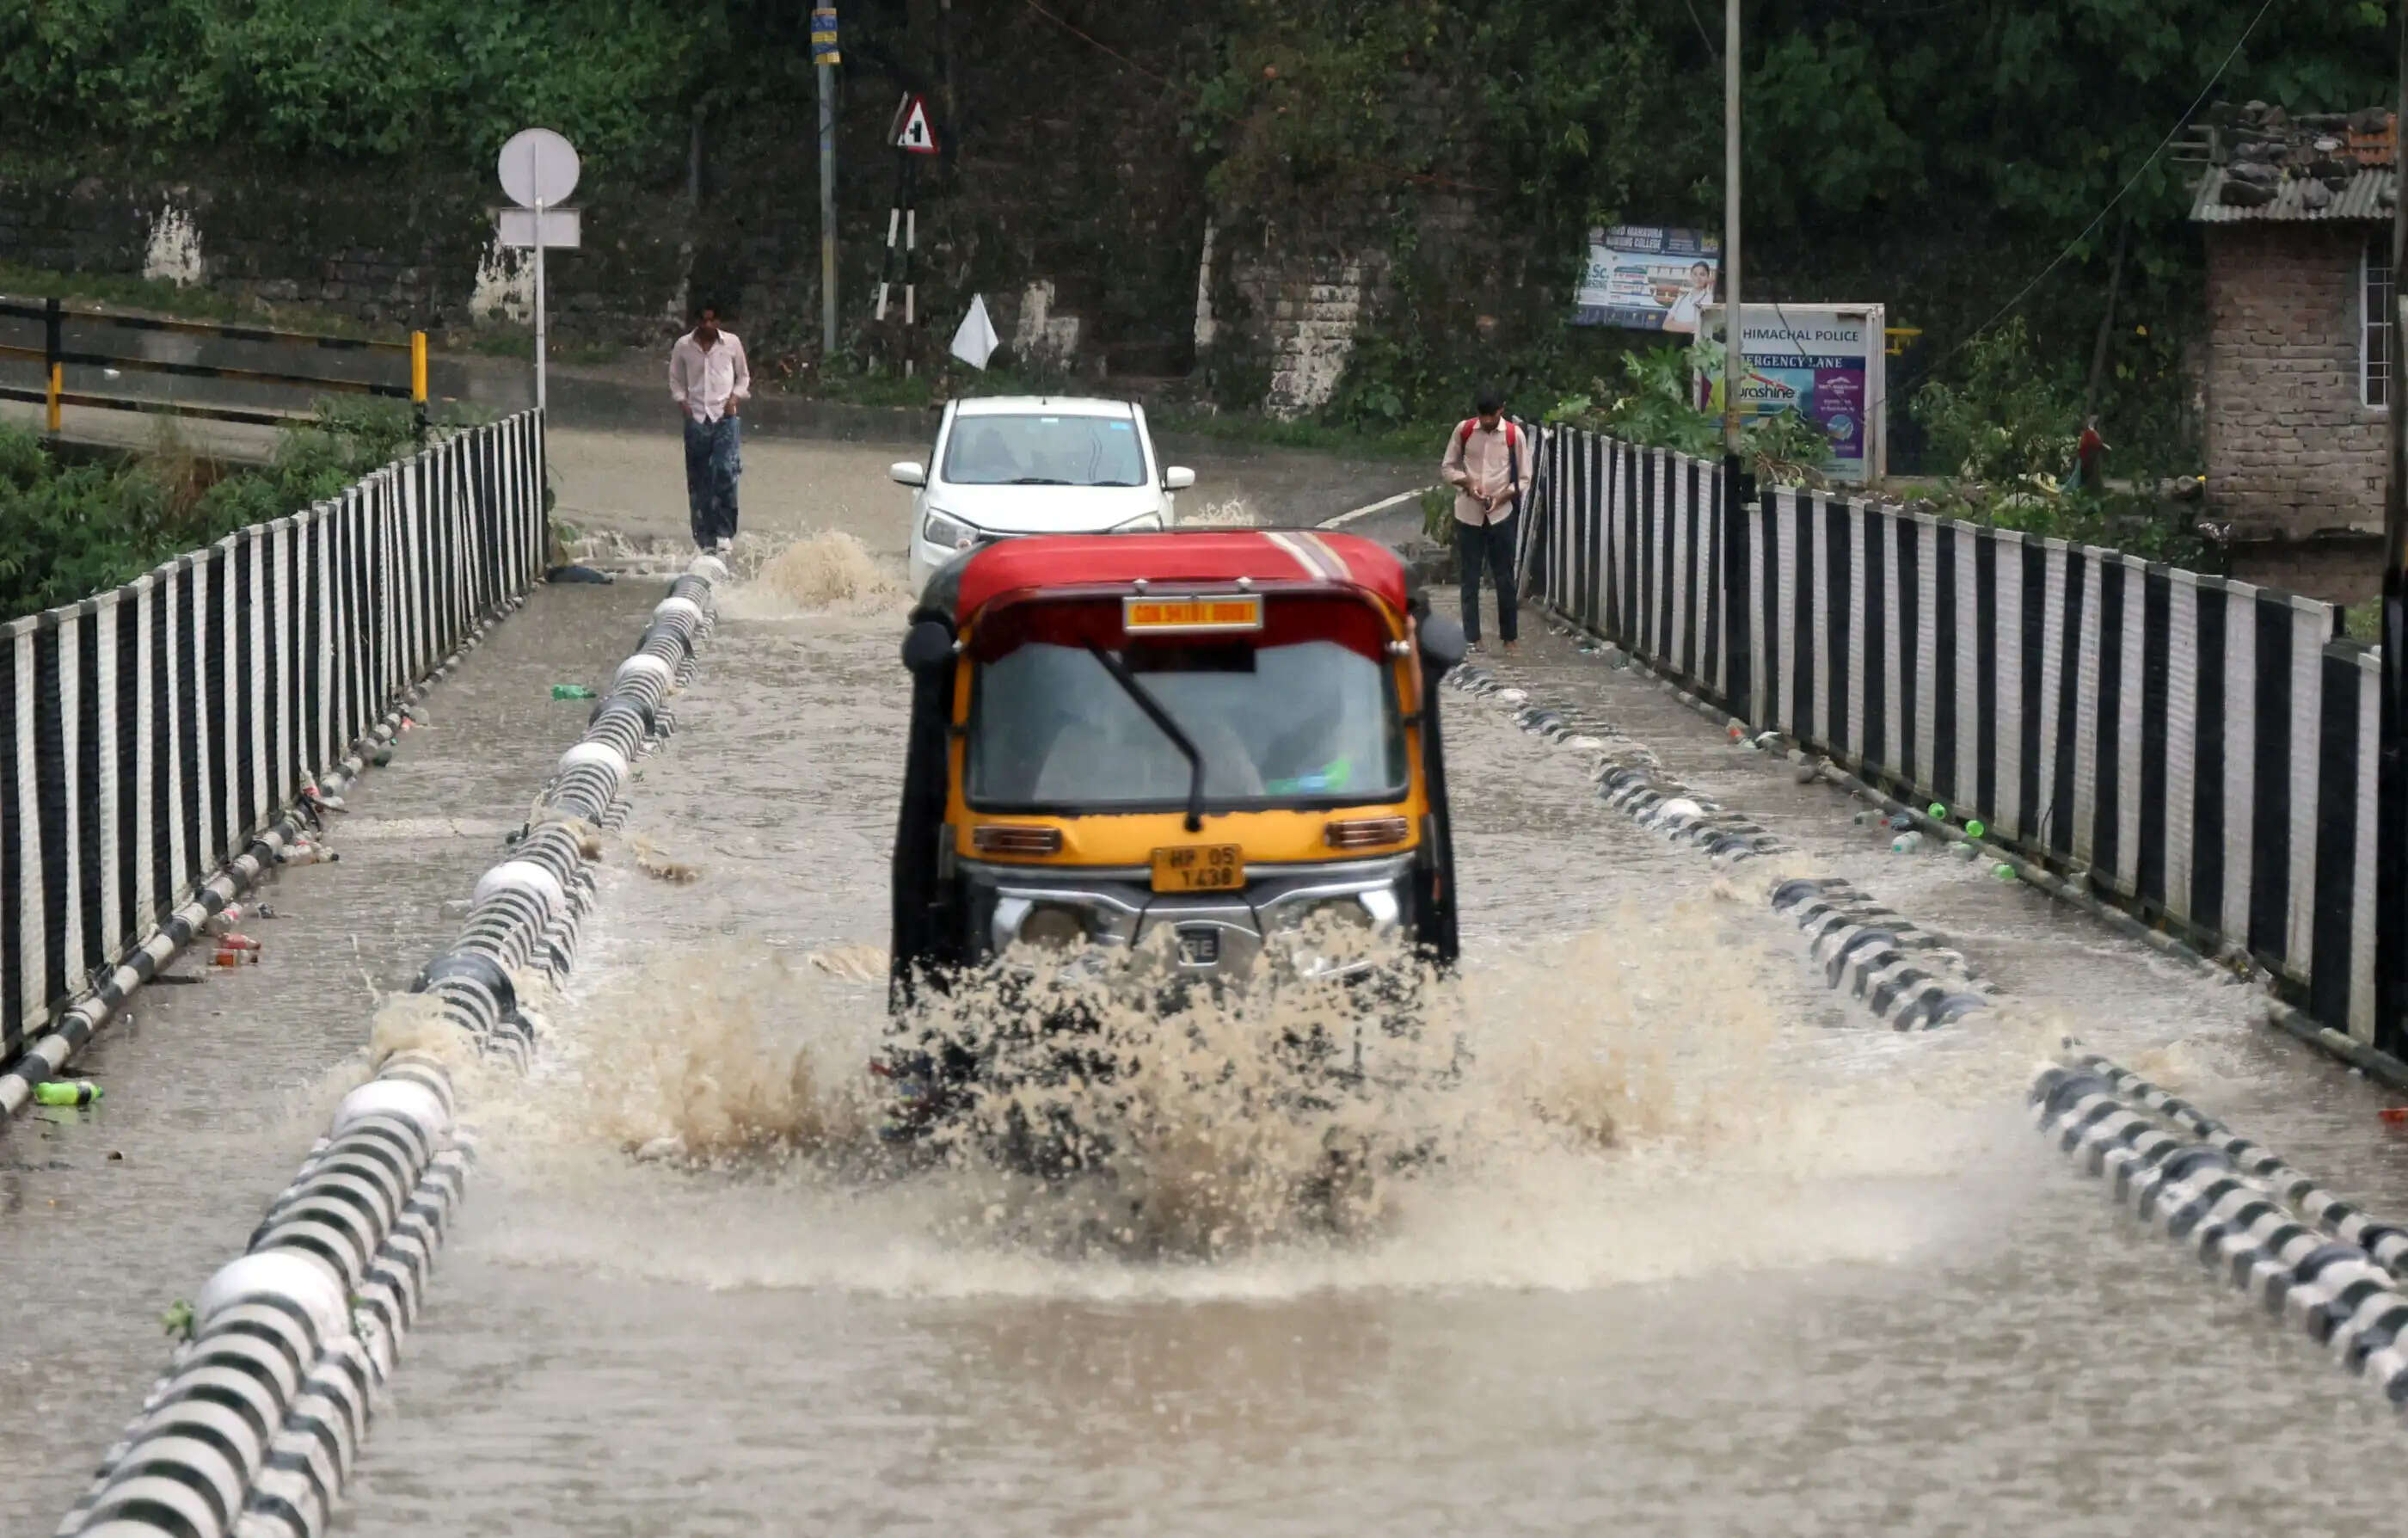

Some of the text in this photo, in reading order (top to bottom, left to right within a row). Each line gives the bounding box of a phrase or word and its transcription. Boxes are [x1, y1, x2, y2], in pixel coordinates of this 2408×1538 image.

[1742, 328, 1858, 342] HIMACHAL POLICE
[1809, 356, 1843, 368] LANE
[1740, 384, 1795, 398] urashine
[1170, 848, 1195, 868] HP
